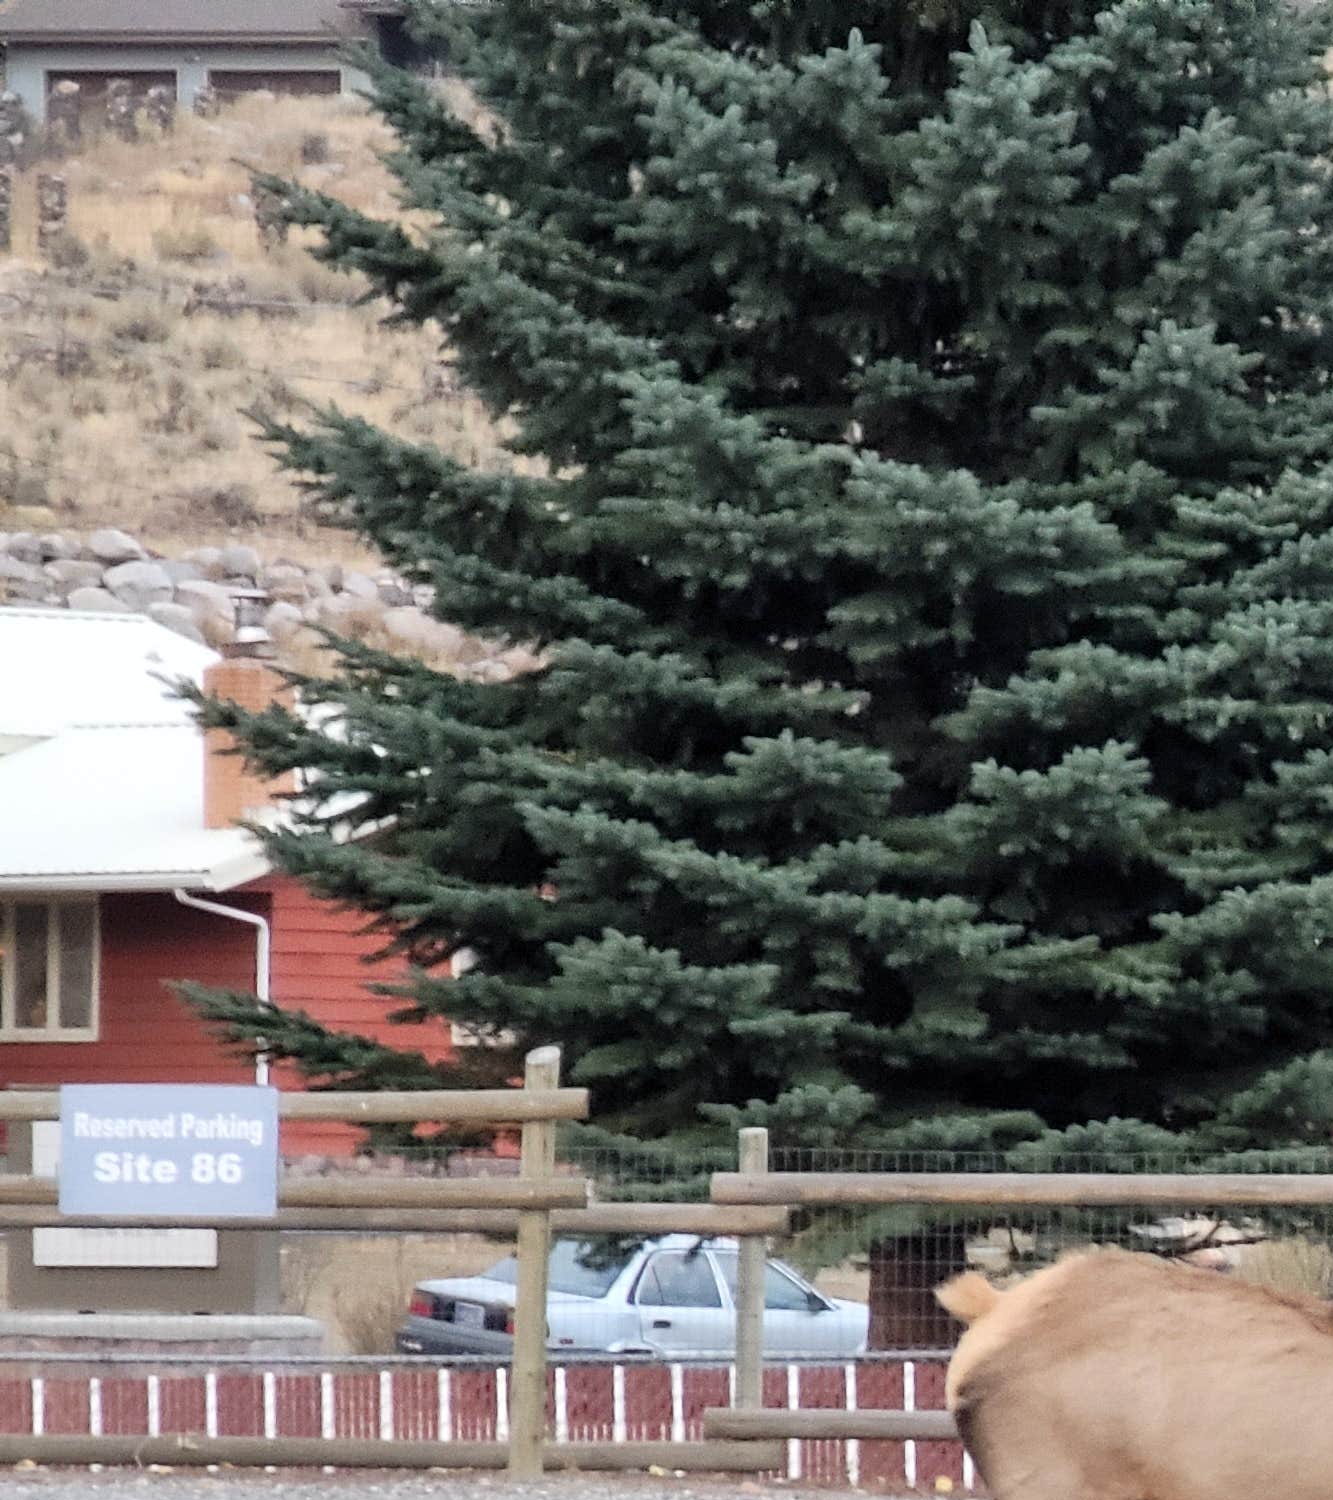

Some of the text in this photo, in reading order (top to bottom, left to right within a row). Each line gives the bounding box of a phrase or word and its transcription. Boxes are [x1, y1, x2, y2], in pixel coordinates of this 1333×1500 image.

[73, 1112, 264, 1146] Reserved Parking
[93, 1152, 243, 1184] Site 86
